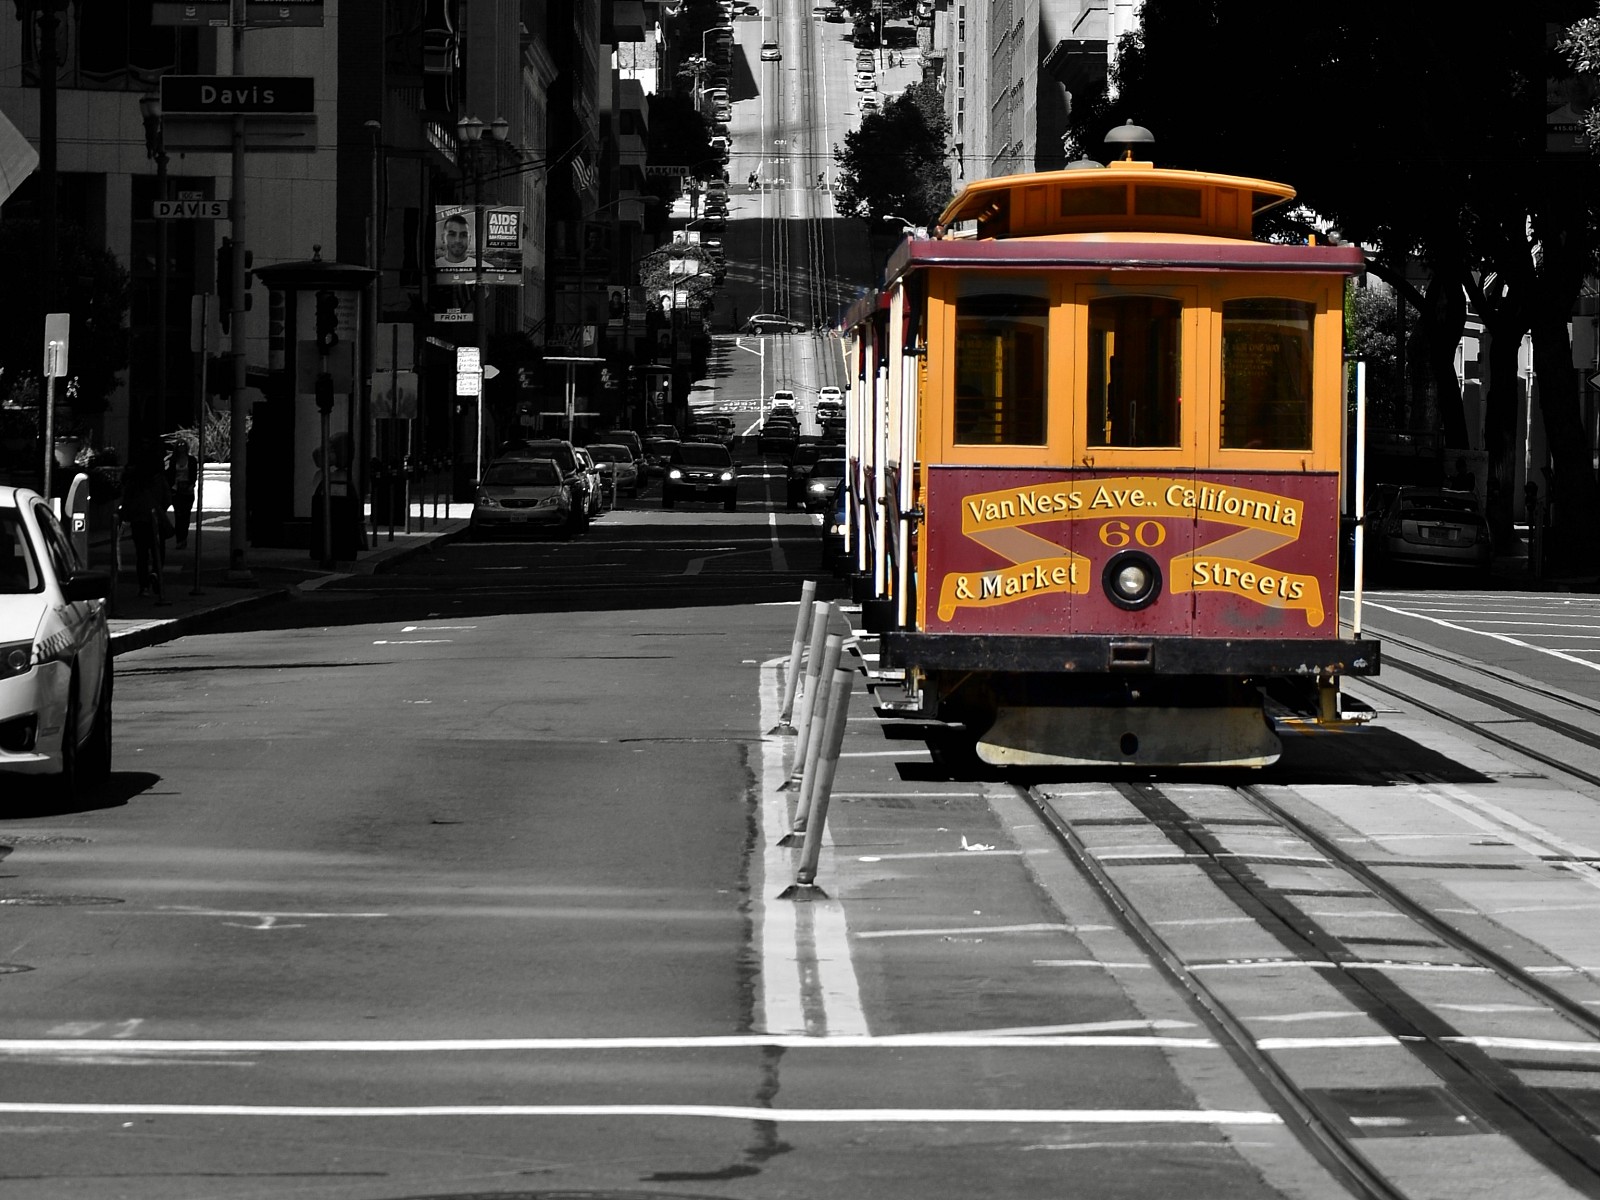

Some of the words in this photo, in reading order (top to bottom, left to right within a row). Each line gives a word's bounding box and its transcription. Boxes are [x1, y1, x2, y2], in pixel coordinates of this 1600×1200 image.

[201, 84, 275, 104] Davis
[160, 203, 221, 215] DAVIS
[489, 213, 518, 225] AIDS
[489, 225, 517, 235] WALK
[969, 496, 1015, 523] Van
[1019, 485, 1083, 515] Ness
[1166, 484, 1298, 526] California
[1099, 520, 1166, 547] 60
[955, 571, 975, 599] &
[981, 561, 1078, 599] Market
[1193, 561, 1304, 599] Streets
